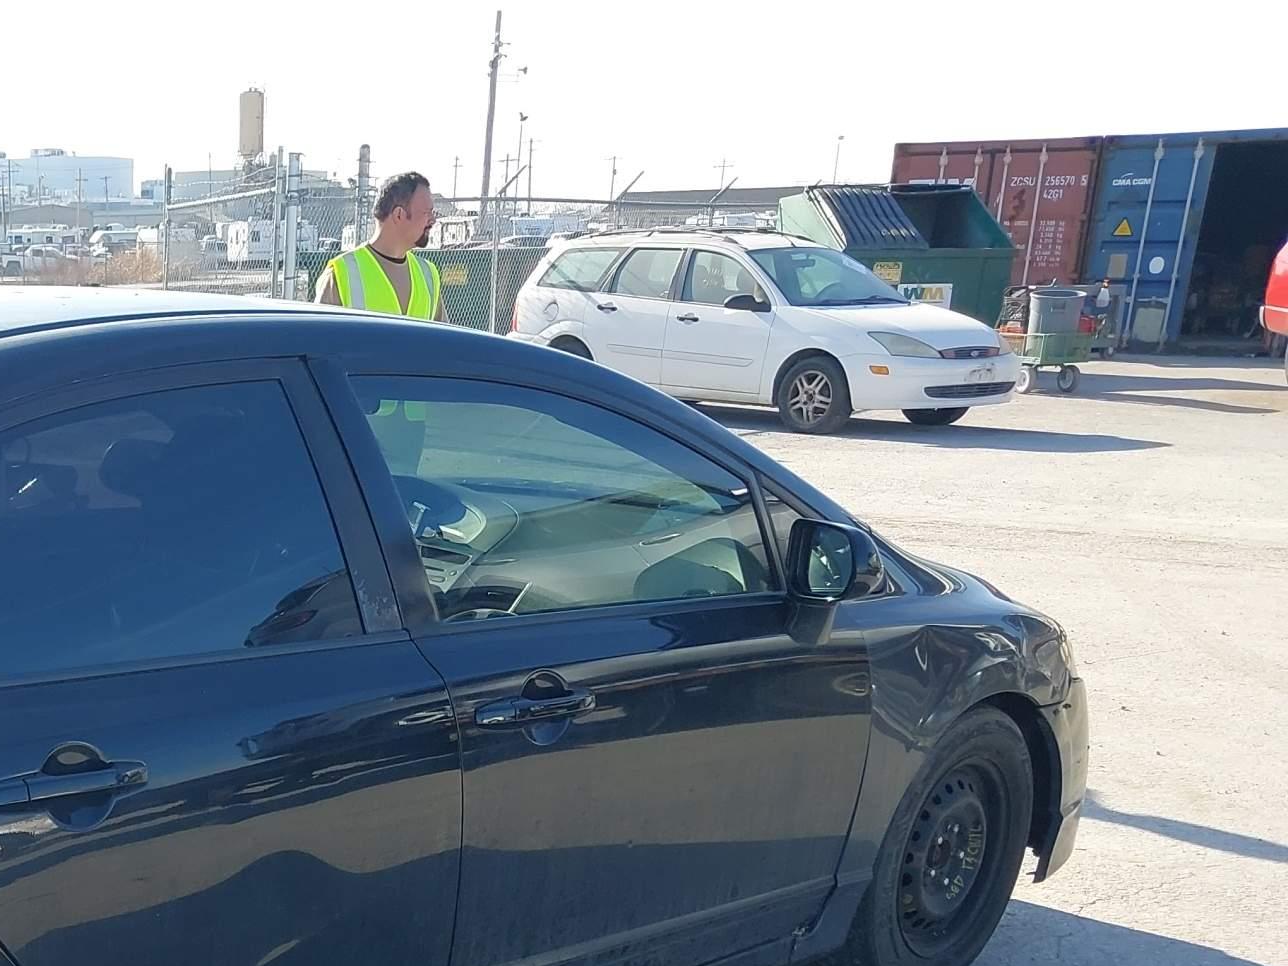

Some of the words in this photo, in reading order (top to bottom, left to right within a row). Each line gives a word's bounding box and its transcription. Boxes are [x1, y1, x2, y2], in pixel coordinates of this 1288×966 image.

[1011, 177, 1035, 187] ZCSU
[1045, 176, 1075, 186] 256570
[1113, 178, 1131, 186] CMA
[1133, 177, 1152, 185] CGM
[903, 287, 944, 300] WM
